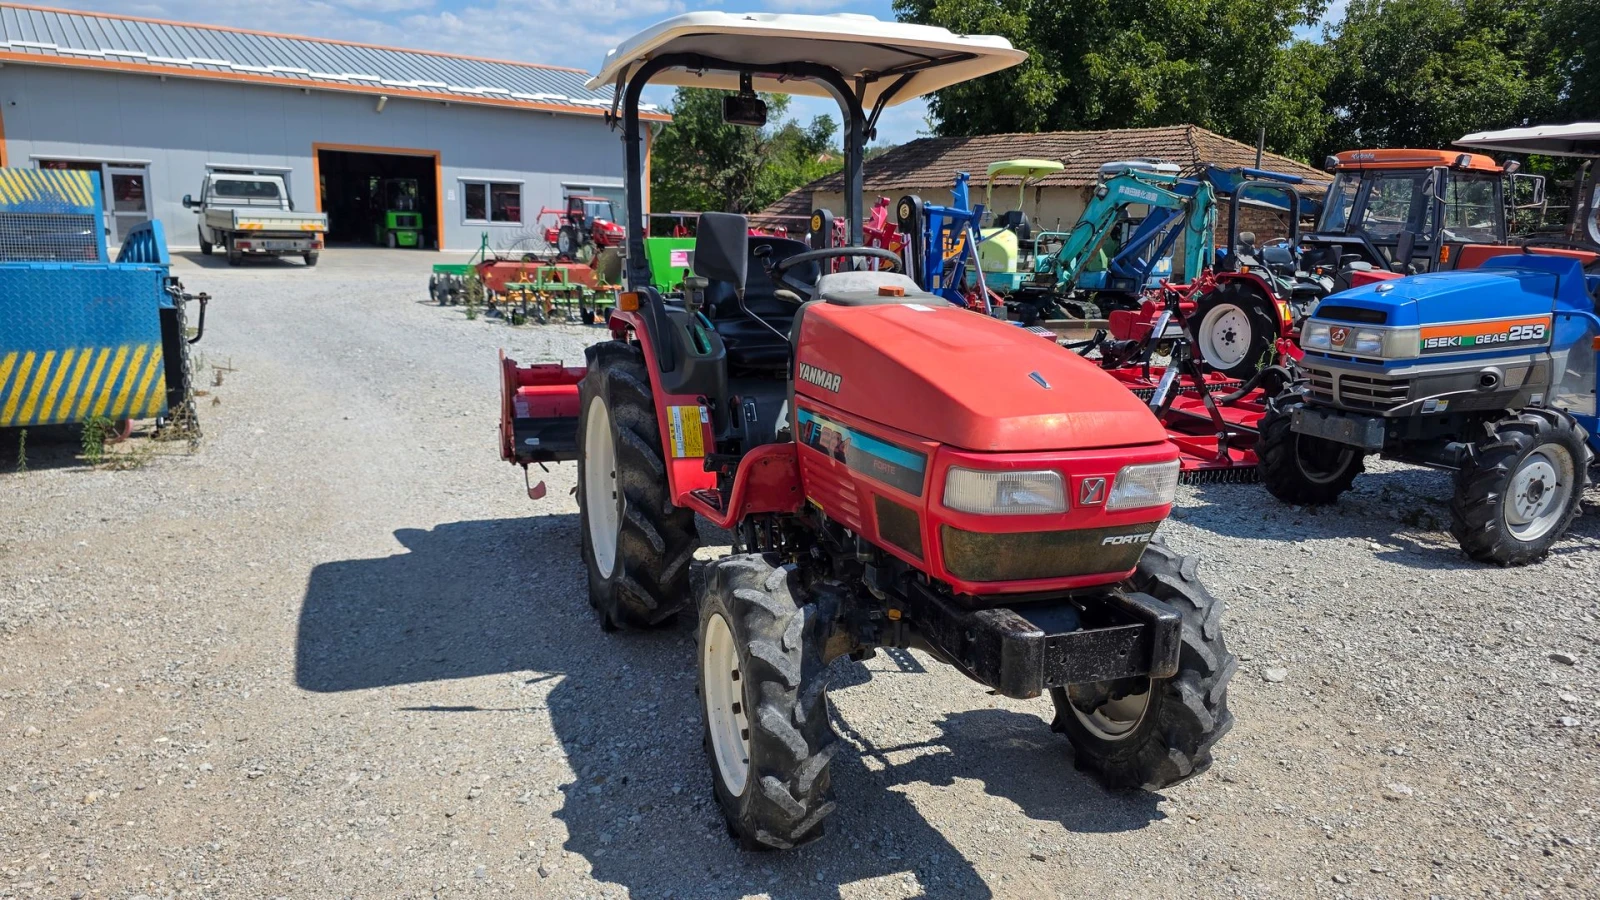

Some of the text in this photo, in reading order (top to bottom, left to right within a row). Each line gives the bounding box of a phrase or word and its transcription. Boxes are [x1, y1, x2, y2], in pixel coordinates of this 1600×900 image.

[1424, 324, 1545, 349] ISEKI GEAS 253
[799, 362, 842, 393] YANMAR
[873, 460, 897, 475] FORTE
[1101, 531, 1152, 546] FORTE
